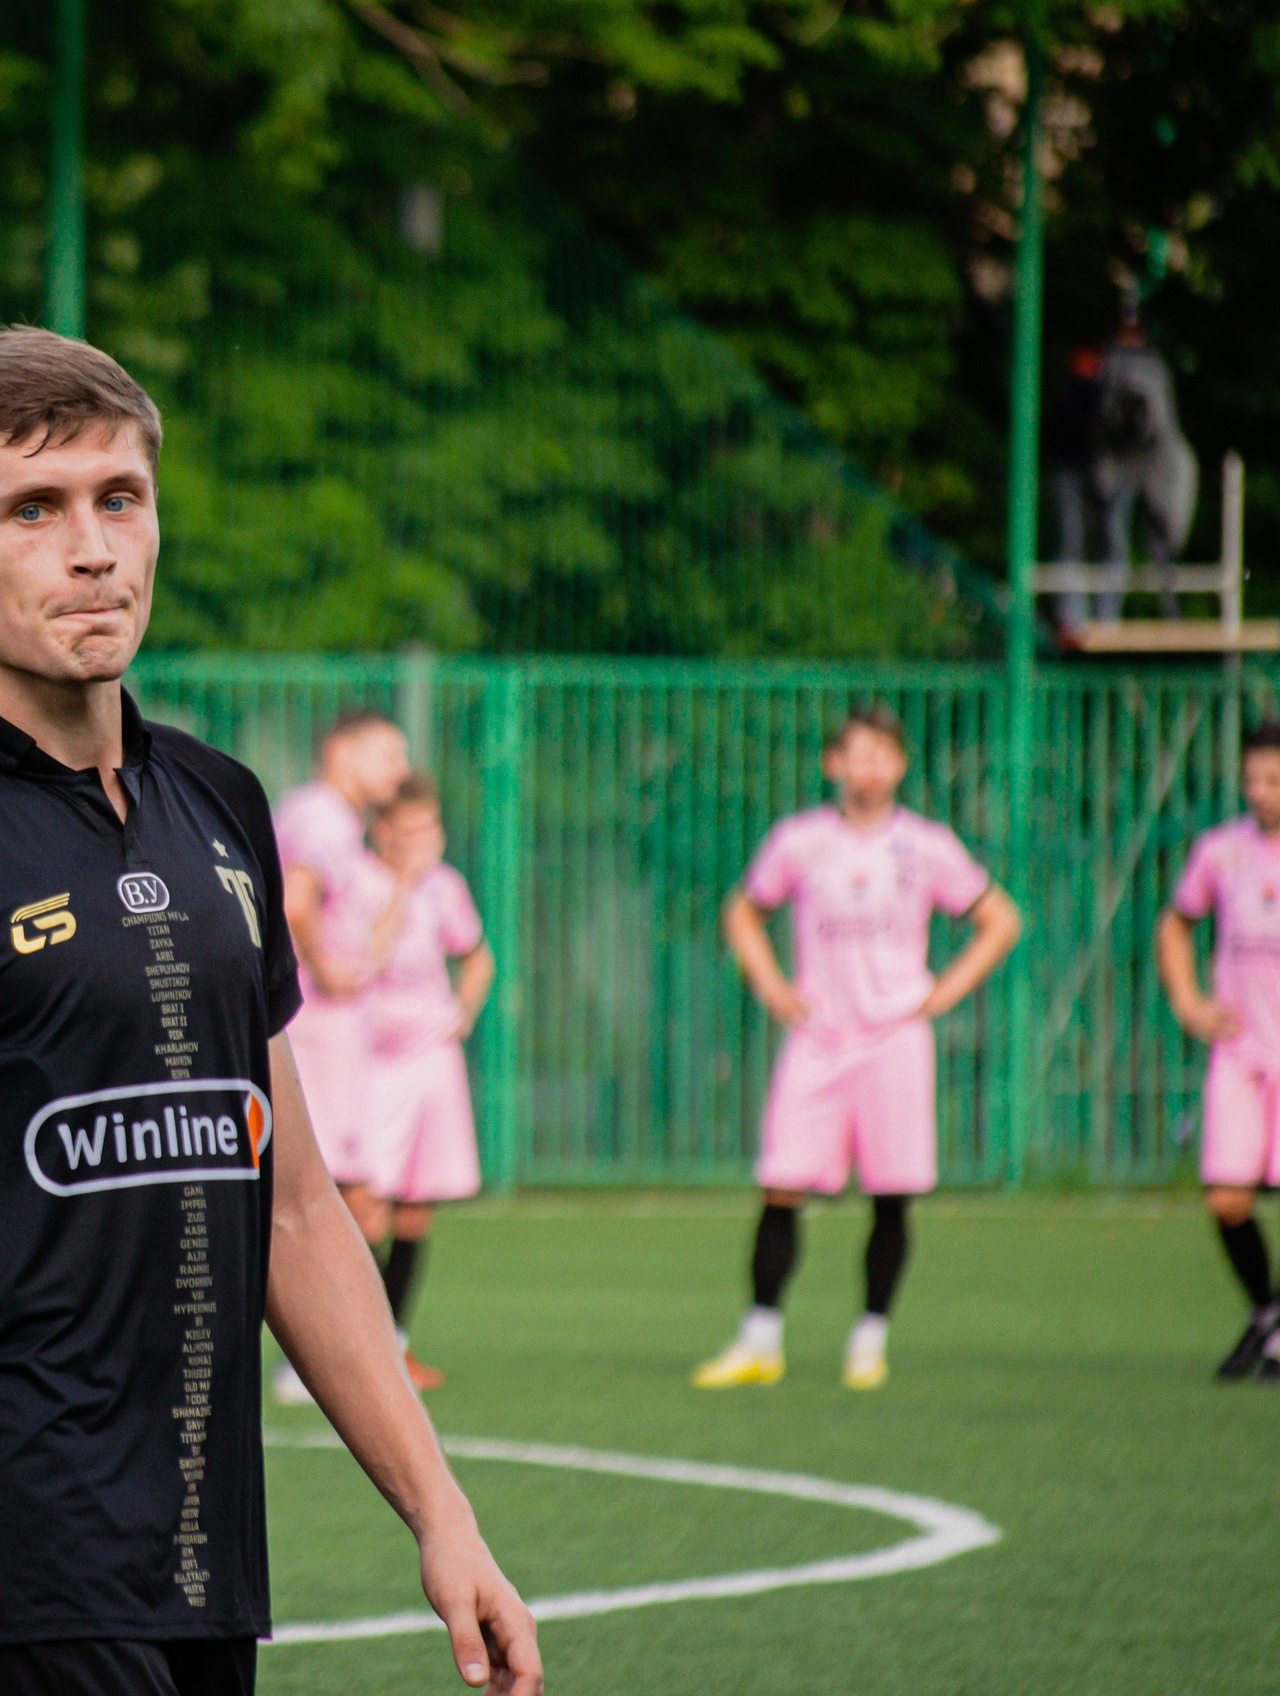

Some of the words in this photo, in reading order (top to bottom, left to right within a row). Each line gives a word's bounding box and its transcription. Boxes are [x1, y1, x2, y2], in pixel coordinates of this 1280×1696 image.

[122, 911, 167, 928] CHAMPIONS
[147, 924, 170, 936] TITAN
[149, 937, 174, 950] ZAYKA
[155, 951, 174, 962] ARBI
[145, 963, 190, 977] SHEPLYAKOV
[149, 976, 190, 990] SHUSTIKOV
[151, 989, 192, 1003] LUSHNIKOV
[161, 1003, 179, 1015] BRAT
[161, 1016, 179, 1028] BRAT
[154, 1042, 199, 1056] KHARLAMOV
[57, 1104, 239, 1170] Winline
